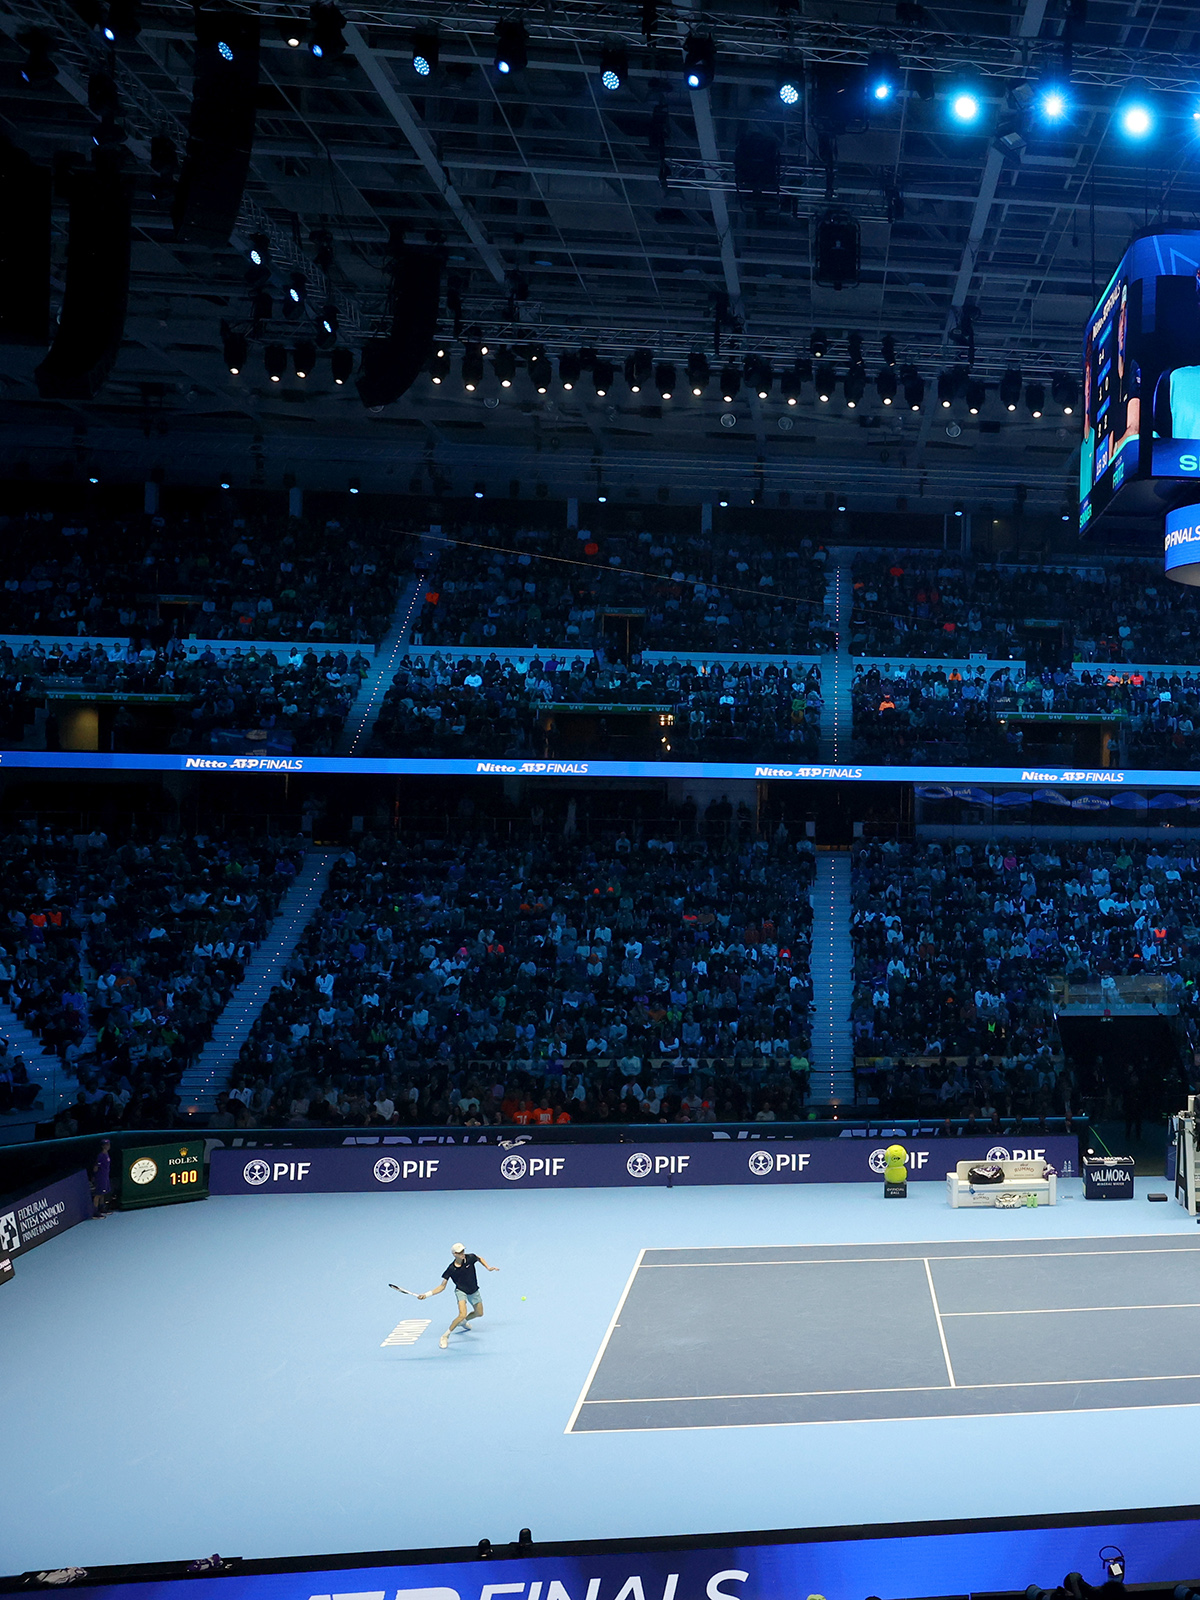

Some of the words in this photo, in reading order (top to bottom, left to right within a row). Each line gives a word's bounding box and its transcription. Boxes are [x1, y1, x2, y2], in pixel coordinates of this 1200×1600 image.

[185, 757, 227, 769] Nitto
[229, 758, 259, 769] ATP
[259, 759, 303, 770] FINALS
[476, 762, 516, 773] Nitto
[518, 763, 546, 773] ATP
[546, 763, 589, 774] FINALS
[754, 767, 793, 777] Nitto
[795, 767, 822, 777] ATP
[822, 768, 862, 778] FINALS
[1021, 771, 1058, 781] Nitto
[1060, 771, 1086, 781] ATP
[1086, 772, 1124, 782] FINALS
[168, 1155, 198, 1166] ROLEX
[529, 1157, 565, 1176] PIF
[655, 1155, 690, 1174] PIF
[776, 1153, 811, 1172] PIF
[273, 1162, 311, 1181] PIF
[402, 1160, 440, 1179] PIF
[1090, 1169, 1131, 1182] VALMORA
[169, 1170, 198, 1185] 1:00
[17, 1197, 49, 1220] FIDEURAM
